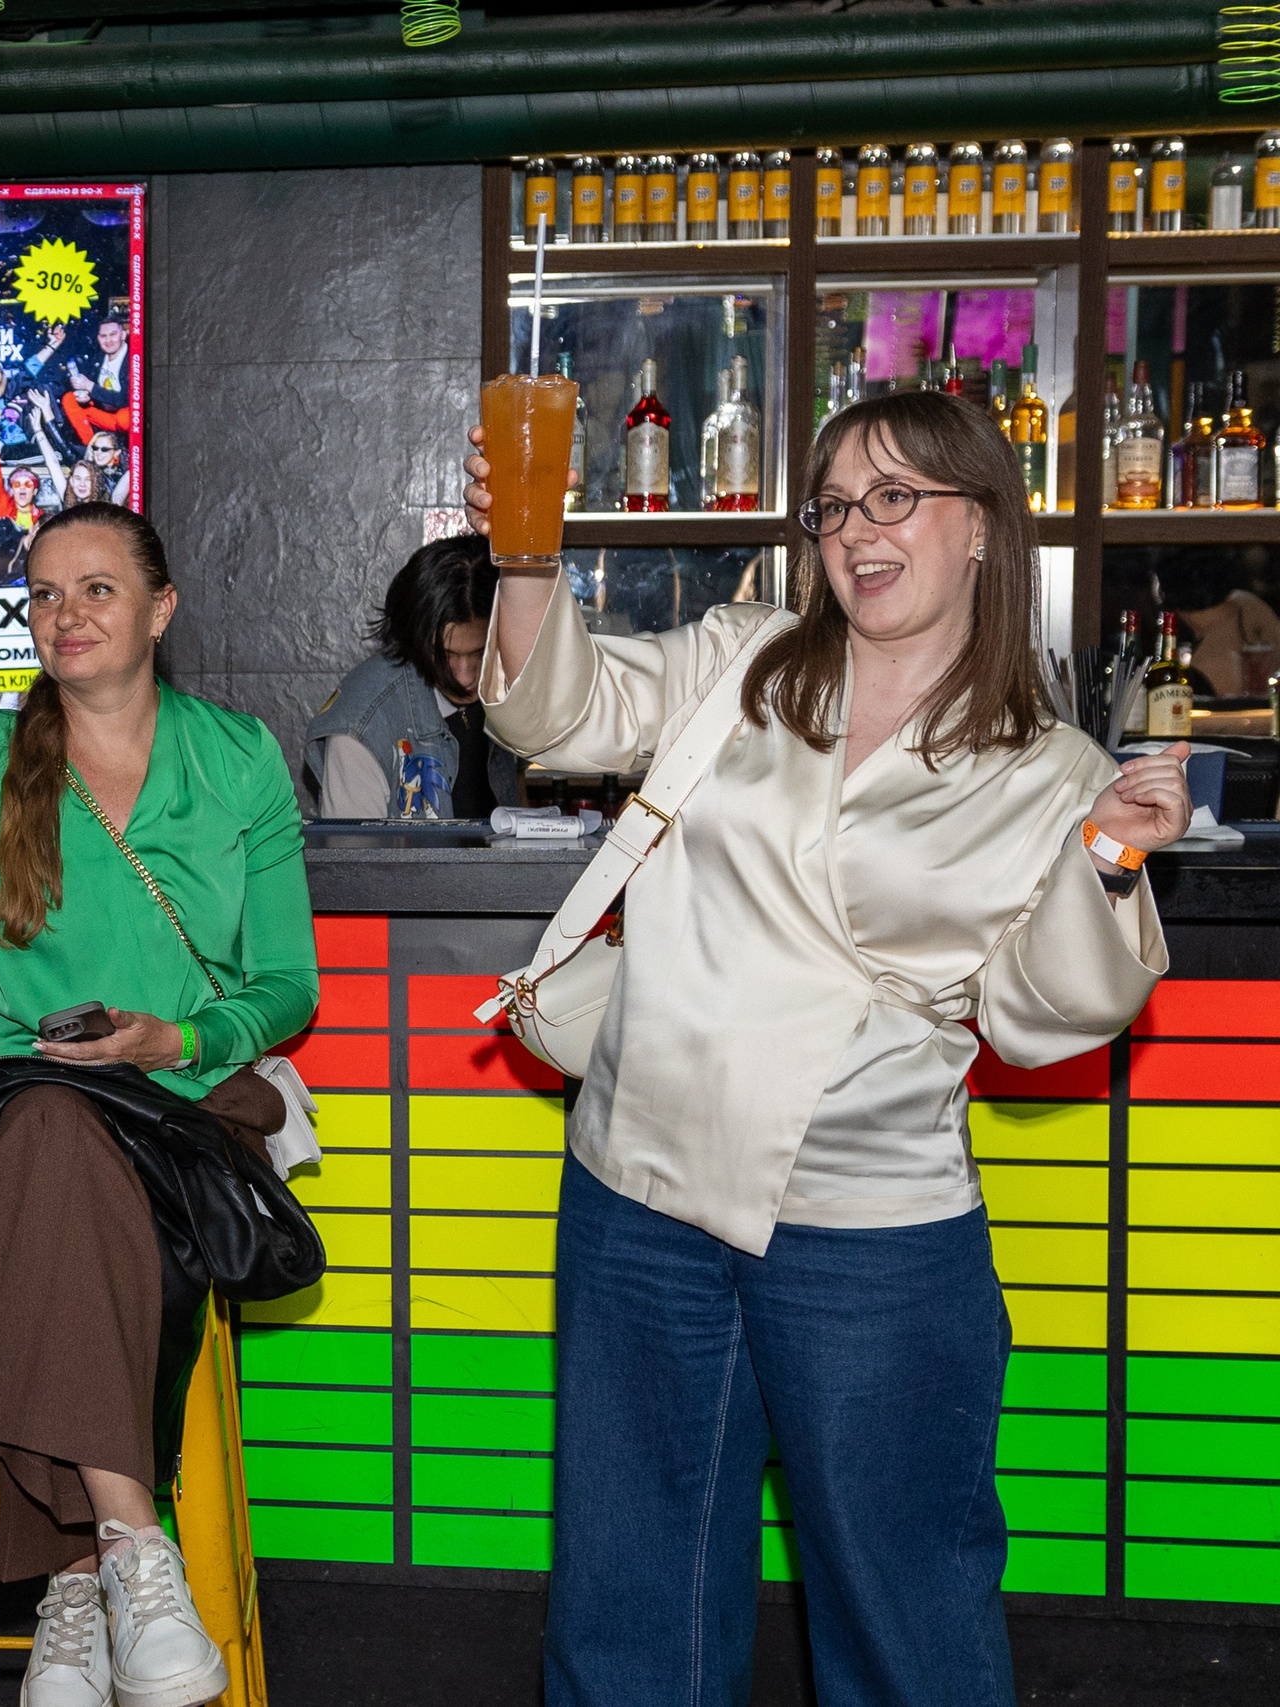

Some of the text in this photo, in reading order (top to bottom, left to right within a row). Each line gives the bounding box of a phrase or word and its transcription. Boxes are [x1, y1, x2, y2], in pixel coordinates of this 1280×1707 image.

[24, 187, 103, 195] СДЕЛАНО В 90-Х
[26, 270, 83, 294] -30%
[133, 254, 141, 302] СДЕЛАНО
[133, 311, 141, 335] 90-Х
[132, 353, 141, 400] СДЕЛАНО
[132, 410, 140, 433] 90-Х
[132, 445, 140, 492] СДЕЛАНО
